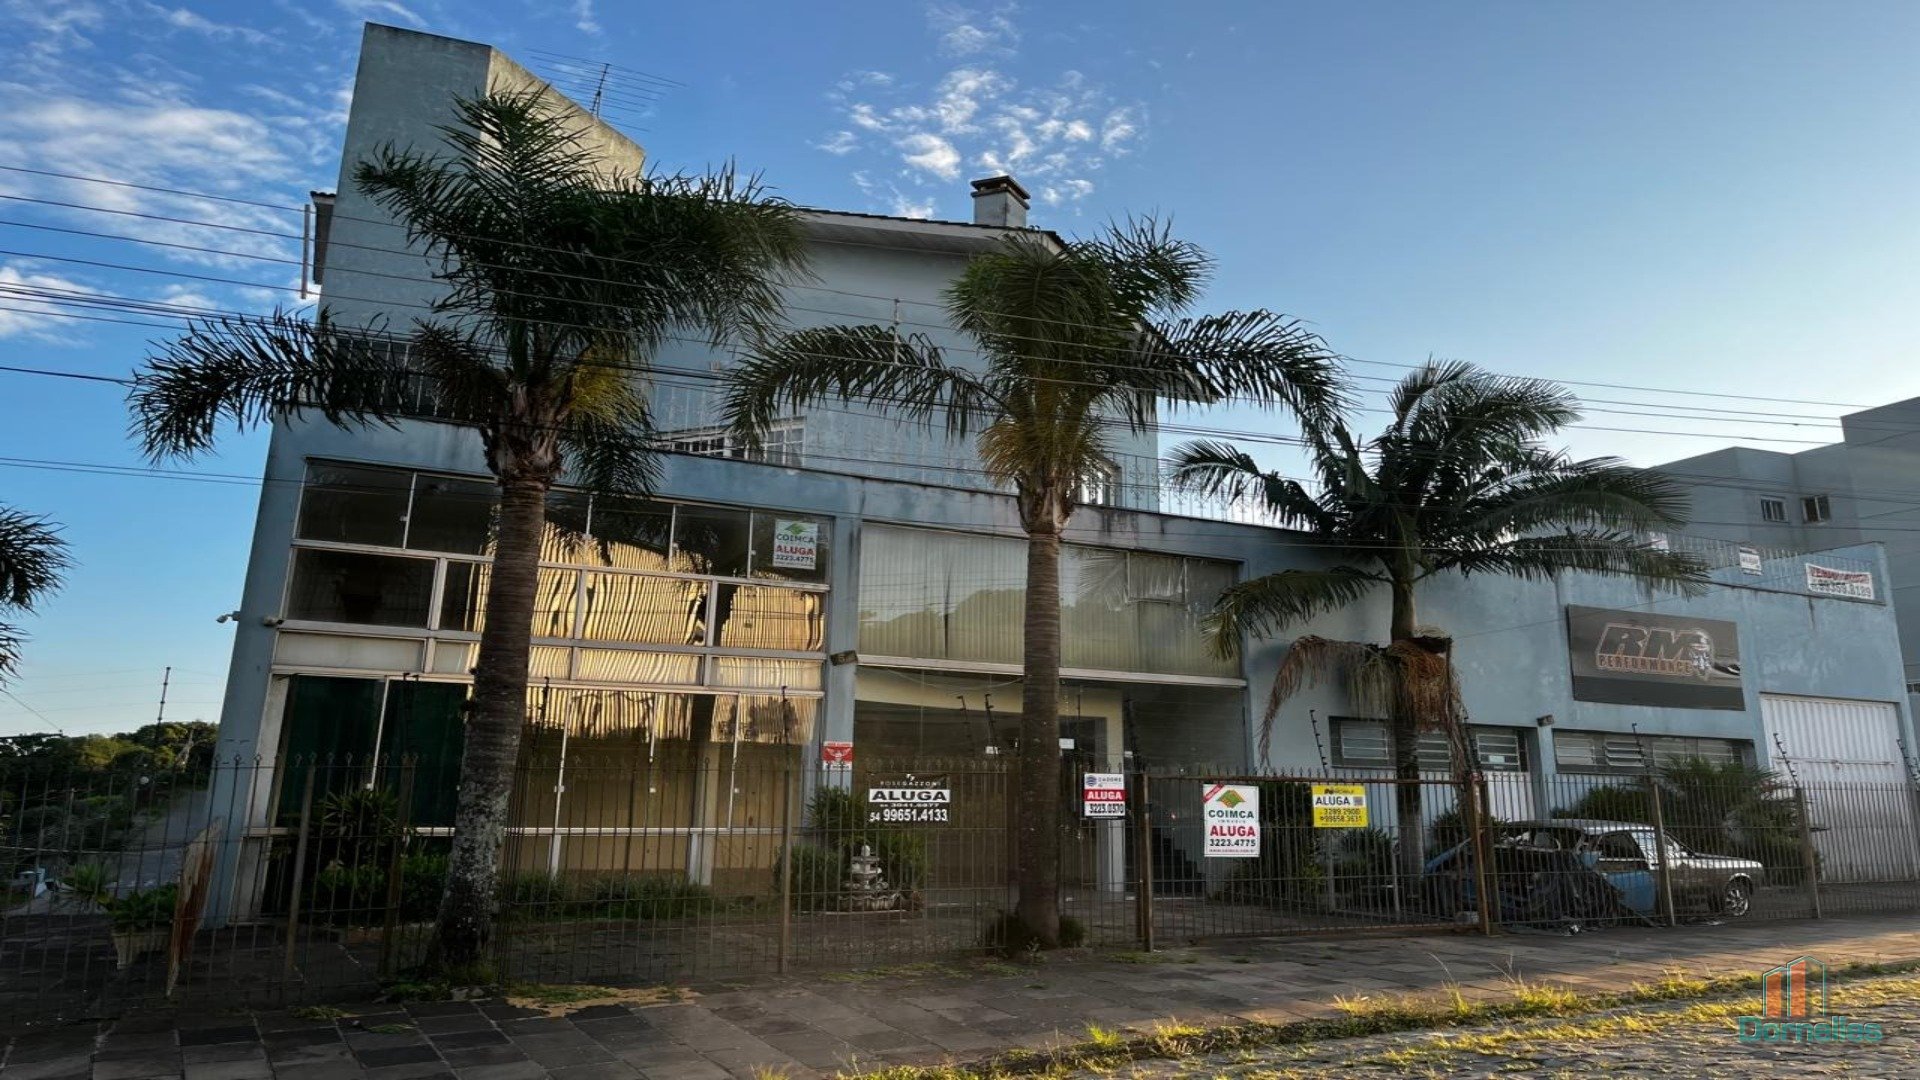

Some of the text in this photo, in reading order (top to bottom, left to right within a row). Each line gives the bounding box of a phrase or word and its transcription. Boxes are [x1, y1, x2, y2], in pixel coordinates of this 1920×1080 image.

[777, 533, 815, 543] COIMCA
[776, 545, 814, 556] ALUGA
[1598, 654, 1694, 674] PERFORMANCE
[871, 791, 947, 801] ALUGA
[1087, 790, 1123, 801] ALUGA
[1315, 796, 1350, 806] ALUGA
[869, 808, 948, 823] 54 99651.4133
[1208, 809, 1255, 819] COIMCA
[1210, 825, 1256, 837] ALUGA
[1209, 838, 1256, 848] 3223.4775
